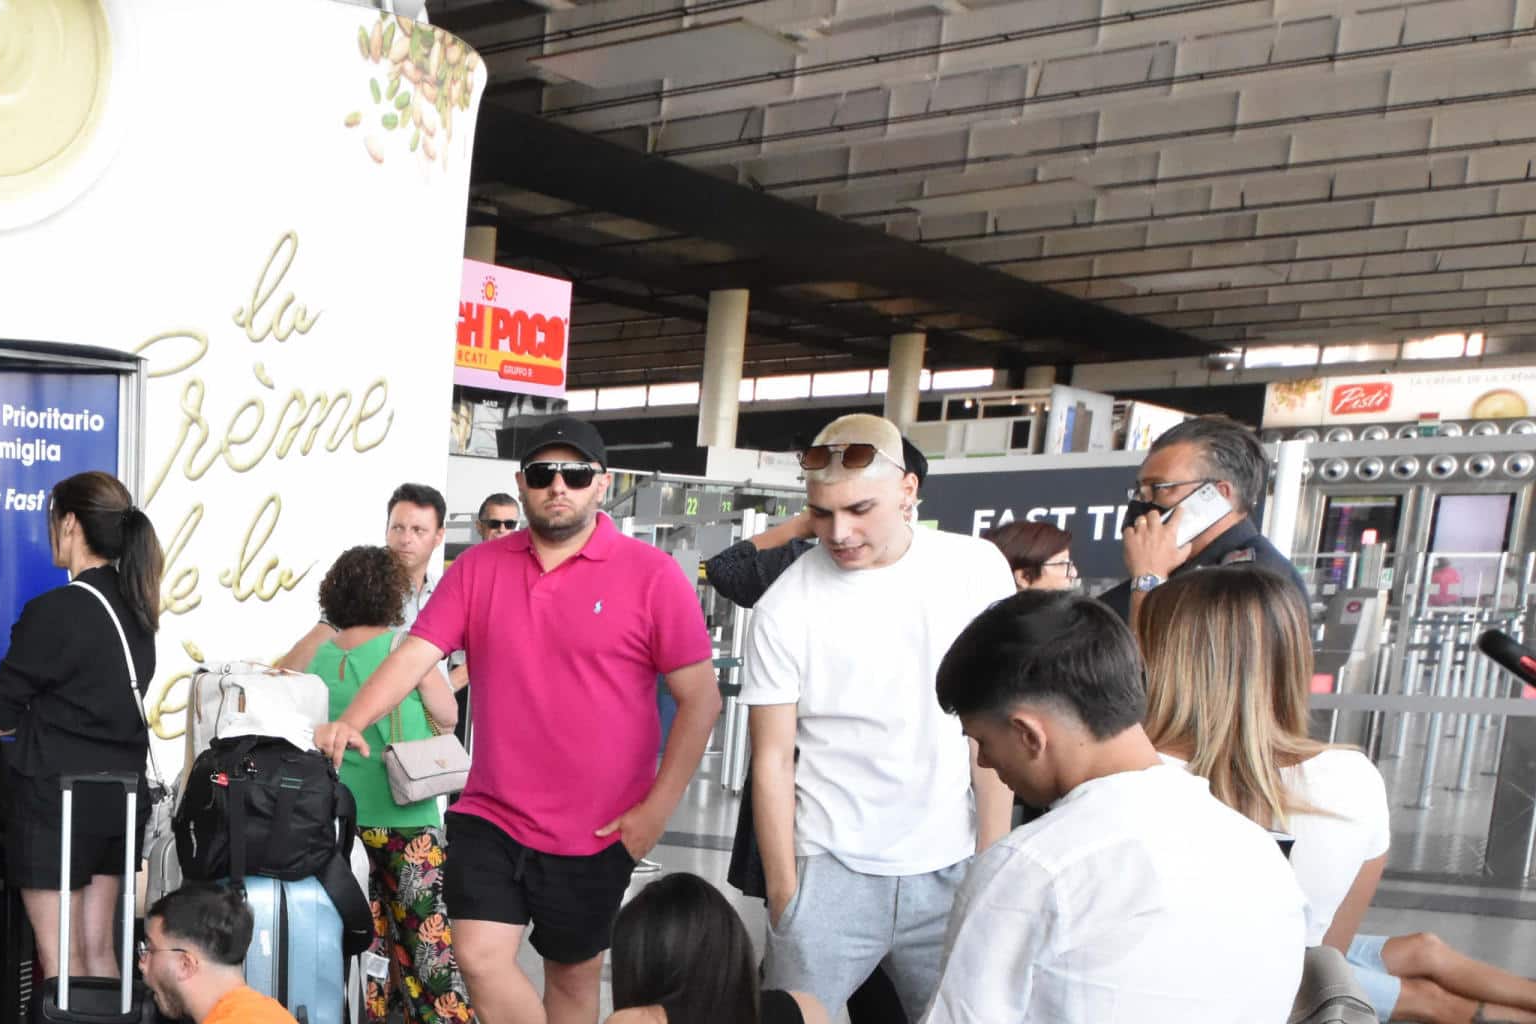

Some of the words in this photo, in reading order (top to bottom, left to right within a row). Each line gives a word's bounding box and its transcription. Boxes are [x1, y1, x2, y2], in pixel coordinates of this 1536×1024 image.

[1335, 387, 1390, 411] Pisti
[2, 404, 105, 431] Prioritario
[5, 488, 45, 511] Fast
[687, 498, 698, 515] 22
